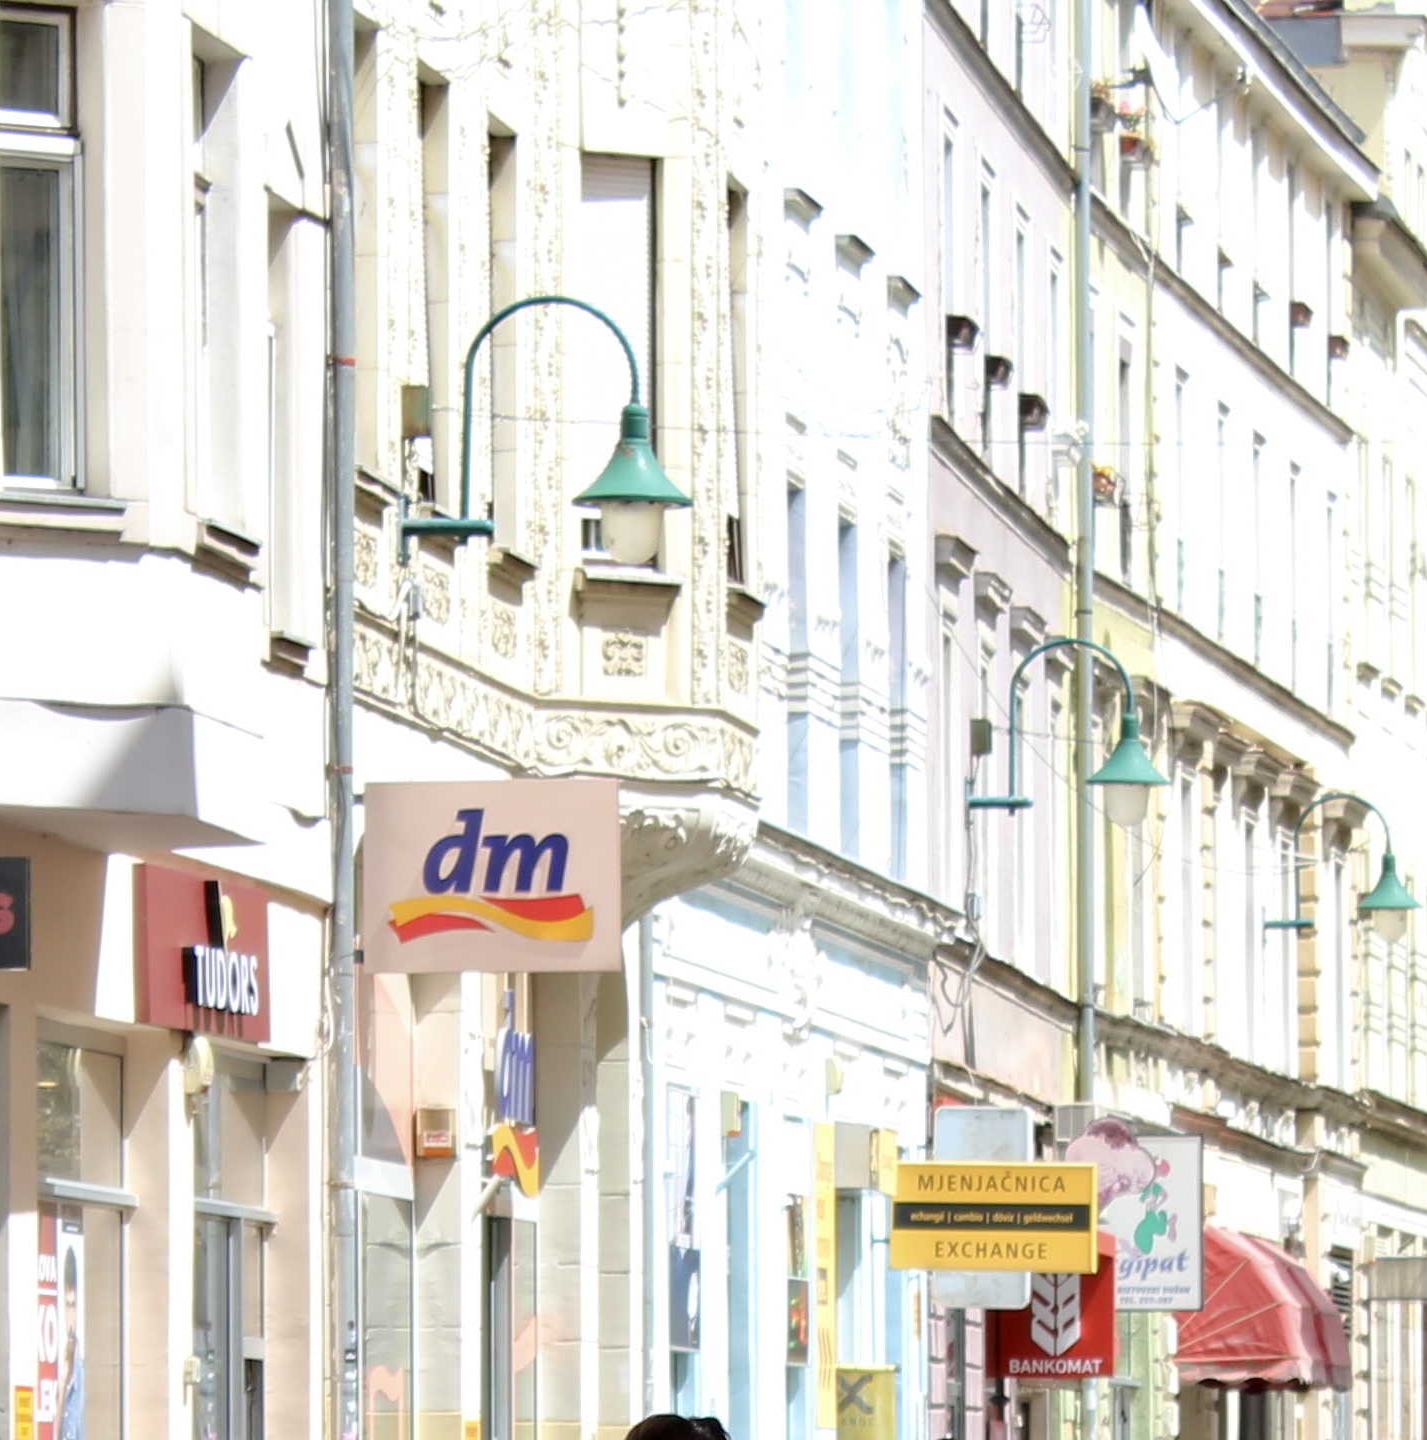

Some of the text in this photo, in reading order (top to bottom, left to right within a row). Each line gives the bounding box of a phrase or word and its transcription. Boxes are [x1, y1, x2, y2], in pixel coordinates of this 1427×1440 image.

[423, 808, 569, 894] dm
[193, 944, 259, 1016] TUDORS
[918, 1171, 1067, 1193] MJENJAČNICA
[934, 1241, 1048, 1260] EXCHANGE
[1117, 1249, 1189, 1281] gipat
[1009, 1359, 1103, 1375] BANKOMAT
